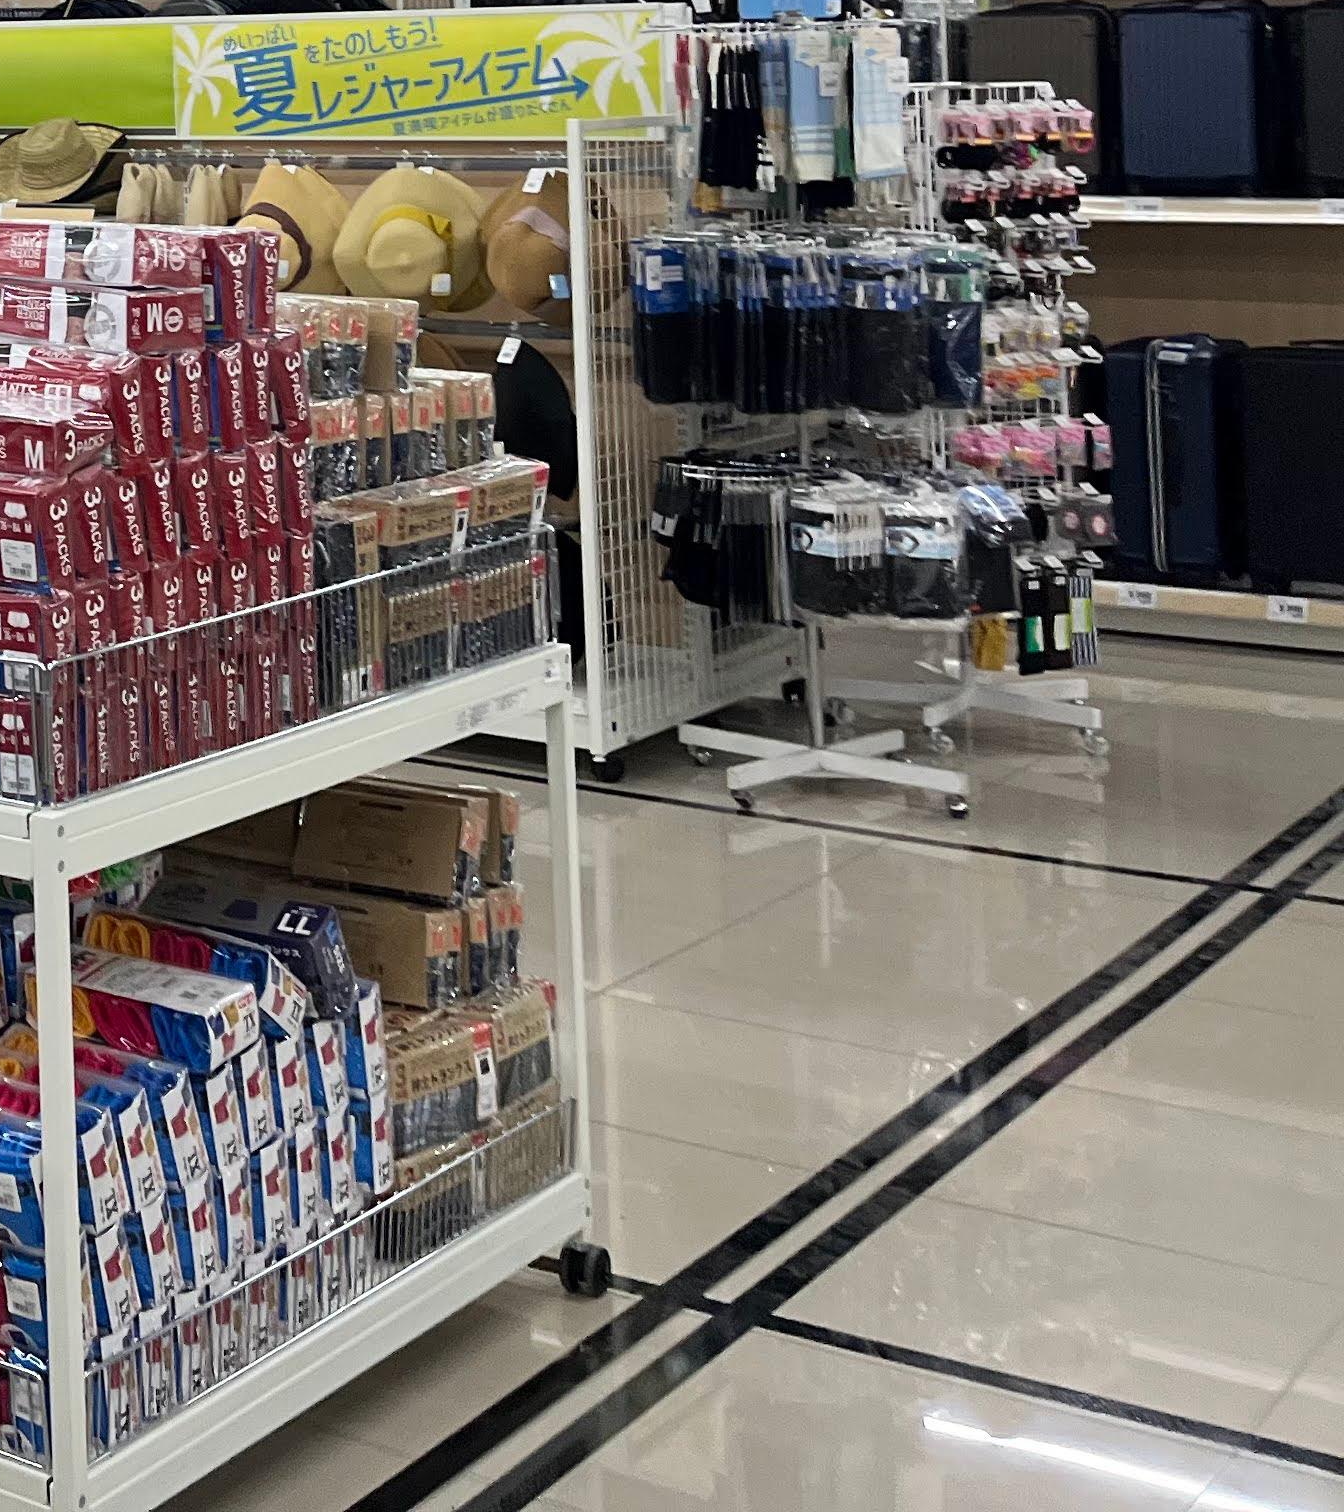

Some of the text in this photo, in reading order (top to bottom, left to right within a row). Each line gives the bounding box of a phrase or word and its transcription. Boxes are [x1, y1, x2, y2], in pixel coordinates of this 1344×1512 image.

[303, 17, 440, 64] をたのしもう!
[223, 43, 312, 133] 夏
[312, 44, 569, 120] レジャーアイテム
[155, 364, 173, 438] 3 PACKS
[285, 351, 307, 421] 3 PACKS
[24, 438, 44, 472] M
[64, 429, 77, 461] 3
[49, 497, 72, 577] 3 PACKS
[84, 486, 106, 564] 3 PACKS
[119, 481, 145, 556] 3 PACKS
[191, 468, 212, 542] 3 PACKS
